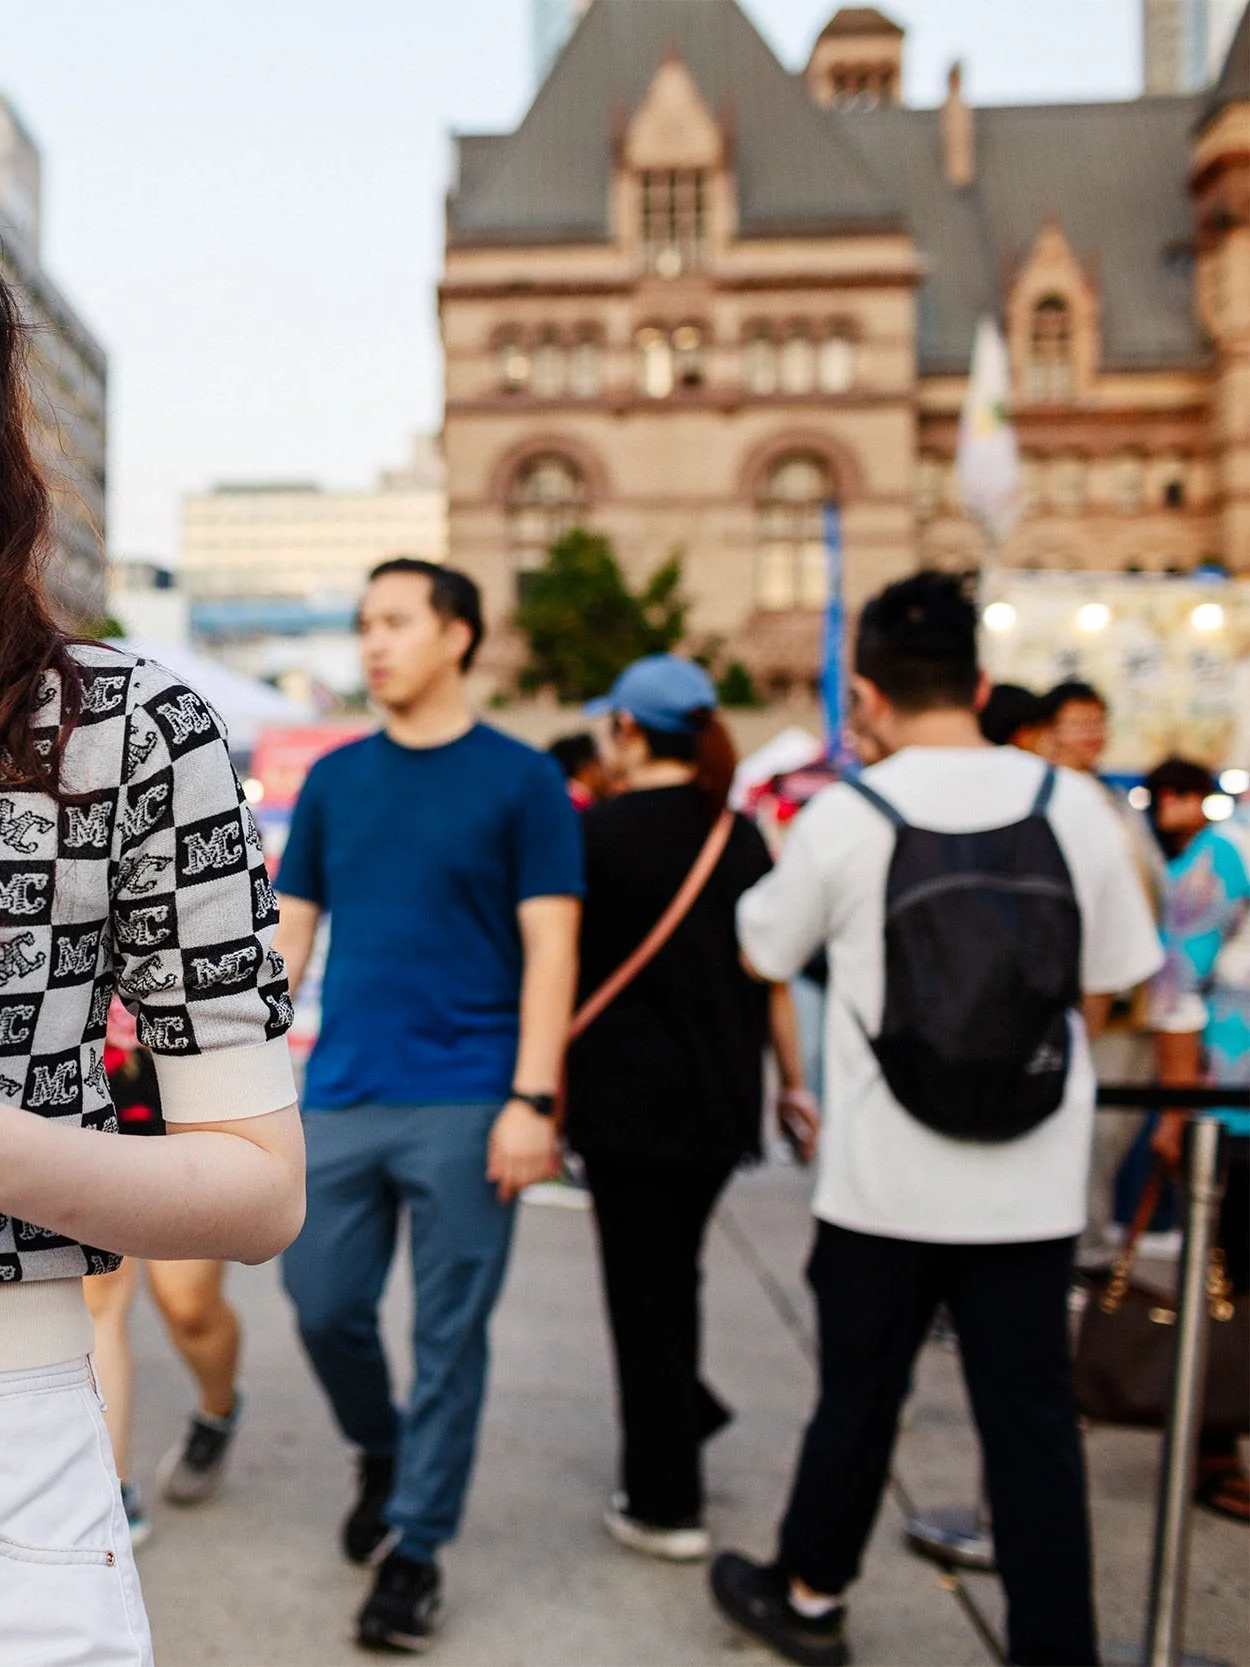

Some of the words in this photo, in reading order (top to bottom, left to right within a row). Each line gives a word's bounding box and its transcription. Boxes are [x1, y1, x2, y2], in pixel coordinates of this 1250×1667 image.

[156, 692, 211, 744] MC
[182, 821, 243, 875] MC
[54, 931, 99, 977] MC
[190, 946, 258, 990] MC
[27, 1059, 79, 1107] MC
